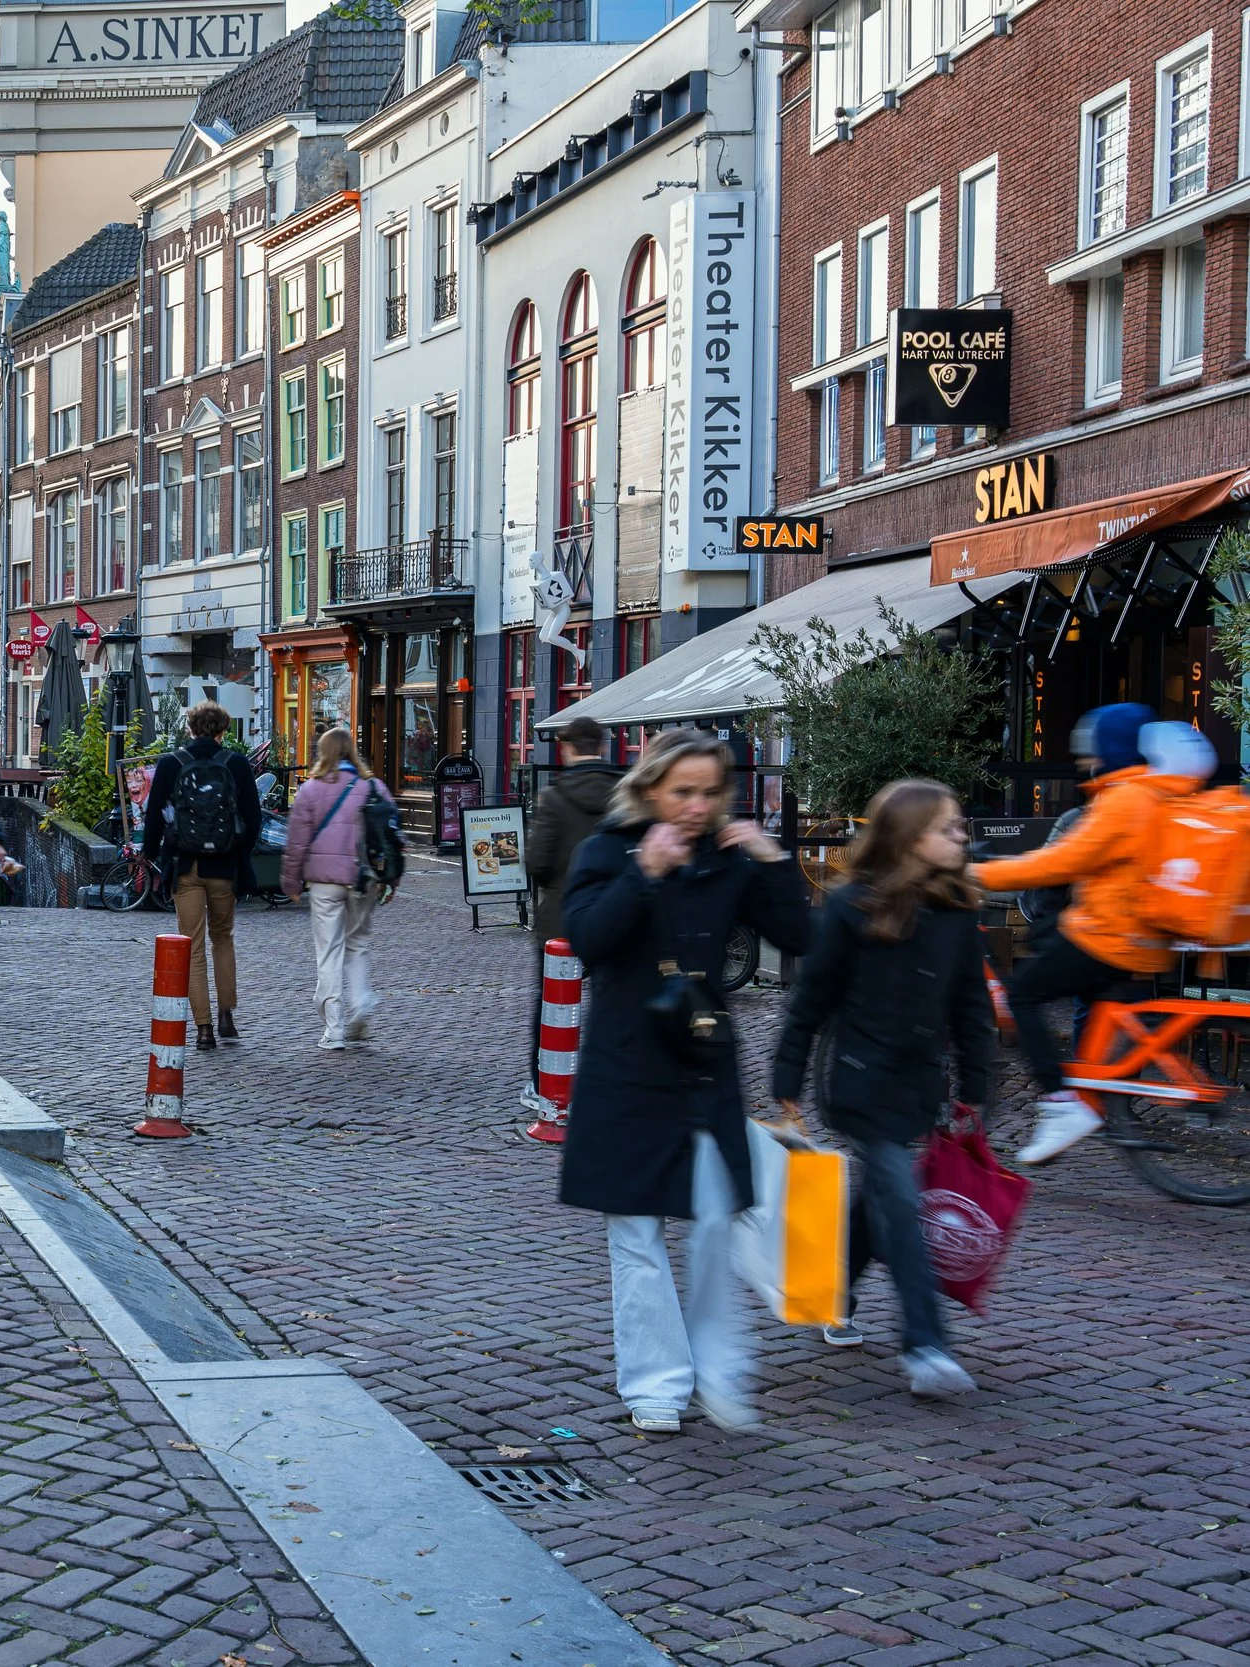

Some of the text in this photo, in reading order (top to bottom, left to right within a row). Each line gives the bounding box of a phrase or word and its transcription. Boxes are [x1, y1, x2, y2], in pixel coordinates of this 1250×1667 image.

[671, 207, 688, 388] Theater
[902, 327, 1006, 349] POOL CAFÉ
[902, 350, 1005, 360] HART VAN UTRECHT
[703, 202, 745, 533] Theater Kikker
[669, 399, 685, 535] Kikker
[975, 454, 1045, 524] STAN
[743, 522, 818, 548] STAN
[1035, 671, 1044, 756] STAN
[1192, 661, 1202, 733] STA
[470, 823, 492, 831] STAN
[501, 814, 511, 822] bij
[983, 825, 1021, 834] TWINTIG
